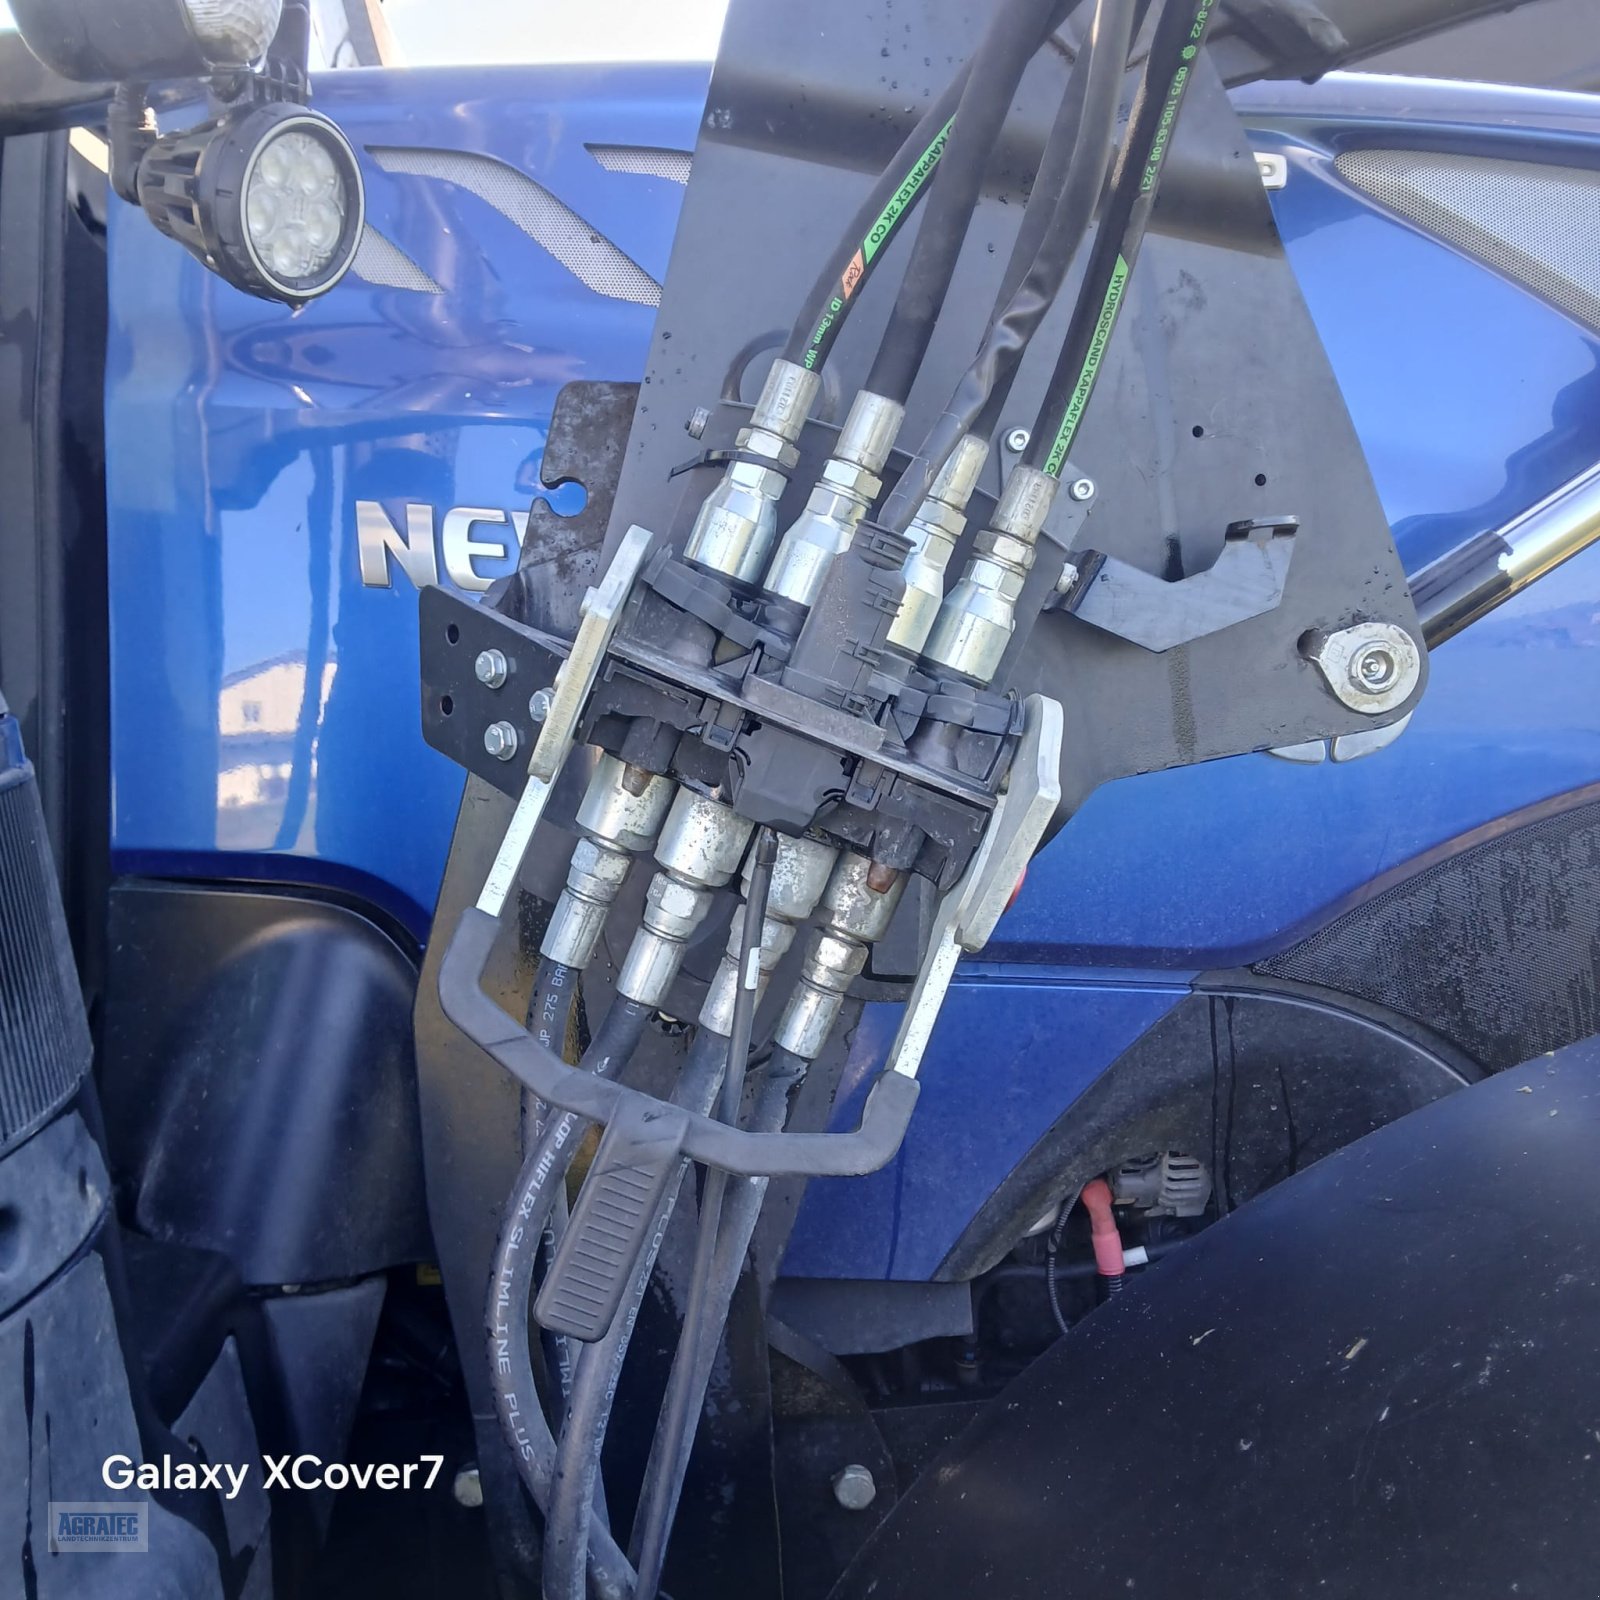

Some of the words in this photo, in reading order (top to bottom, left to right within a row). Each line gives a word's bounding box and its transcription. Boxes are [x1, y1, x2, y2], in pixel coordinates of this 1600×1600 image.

[895, 136, 948, 206] KAPPAFLEX
[870, 223, 887, 244] CO
[883, 204, 899, 224] 2K
[813, 313, 834, 344] 13mm
[830, 297, 843, 311] ID
[1087, 273, 1125, 367] HYDROSCAND
[804, 349, 818, 369] WP
[1060, 370, 1094, 441] KAPPAFLEX
[1052, 444, 1065, 464] 2K
[355, 499, 531, 592] NE
[543, 993, 558, 1021] 275
[518, 1150, 556, 1220] HIFLEX
[496, 1225, 524, 1375] SLIMLINE
[504, 1392, 537, 1462] PLUS
